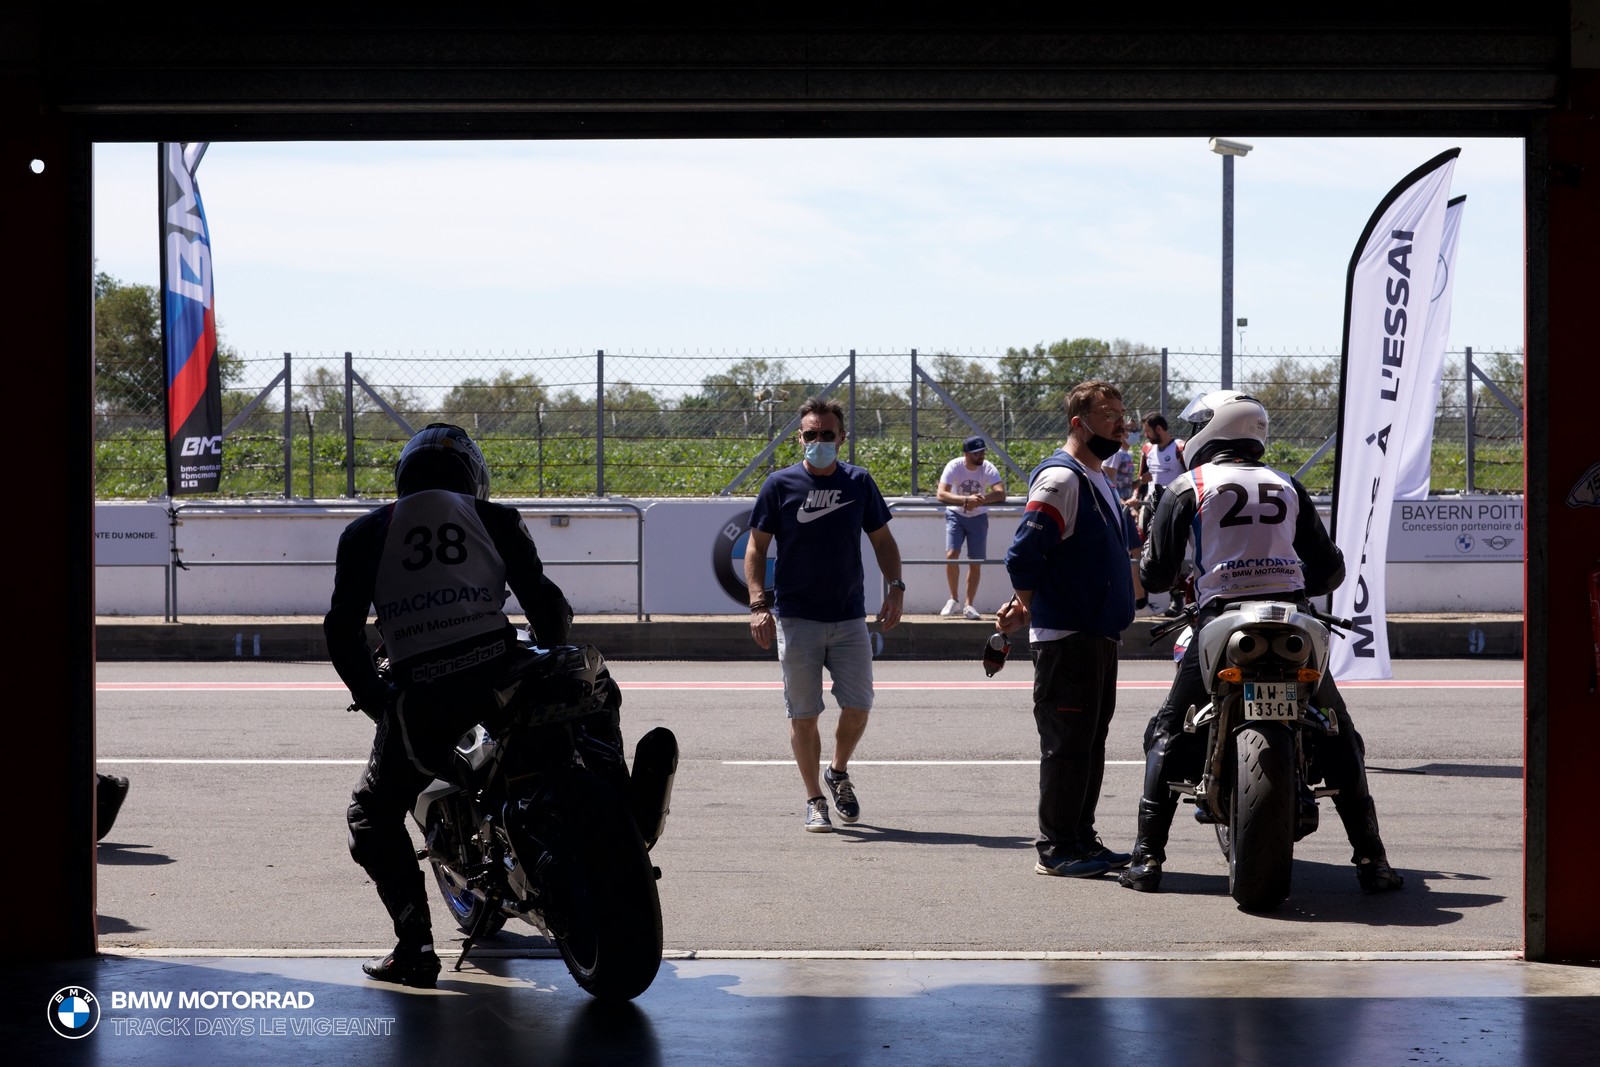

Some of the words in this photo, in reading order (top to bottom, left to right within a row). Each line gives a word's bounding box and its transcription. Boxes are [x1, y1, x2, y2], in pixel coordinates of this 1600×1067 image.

[1365, 423, 1392, 456] À
[1380, 229, 1415, 402] L'ESSAI
[180, 435, 222, 456] BMC
[804, 489, 842, 509] NIKE
[1217, 482, 1288, 528] 25
[1402, 505, 1473, 520] BAYERN
[1478, 504, 1524, 520] POITI
[111, 531, 124, 539] DU
[1402, 521, 1459, 532] Concession
[1460, 522, 1512, 533] partenaire
[402, 522, 468, 571] 38
[1232, 569, 1253, 578] BMW
[1254, 567, 1296, 576] MOTORRAD
[380, 587, 493, 621] TRACKDAYS
[394, 623, 424, 641] BMW
[1468, 628, 1486, 654] 9
[413, 641, 505, 682] alpinestars
[1248, 702, 1294, 717] 133-CA
